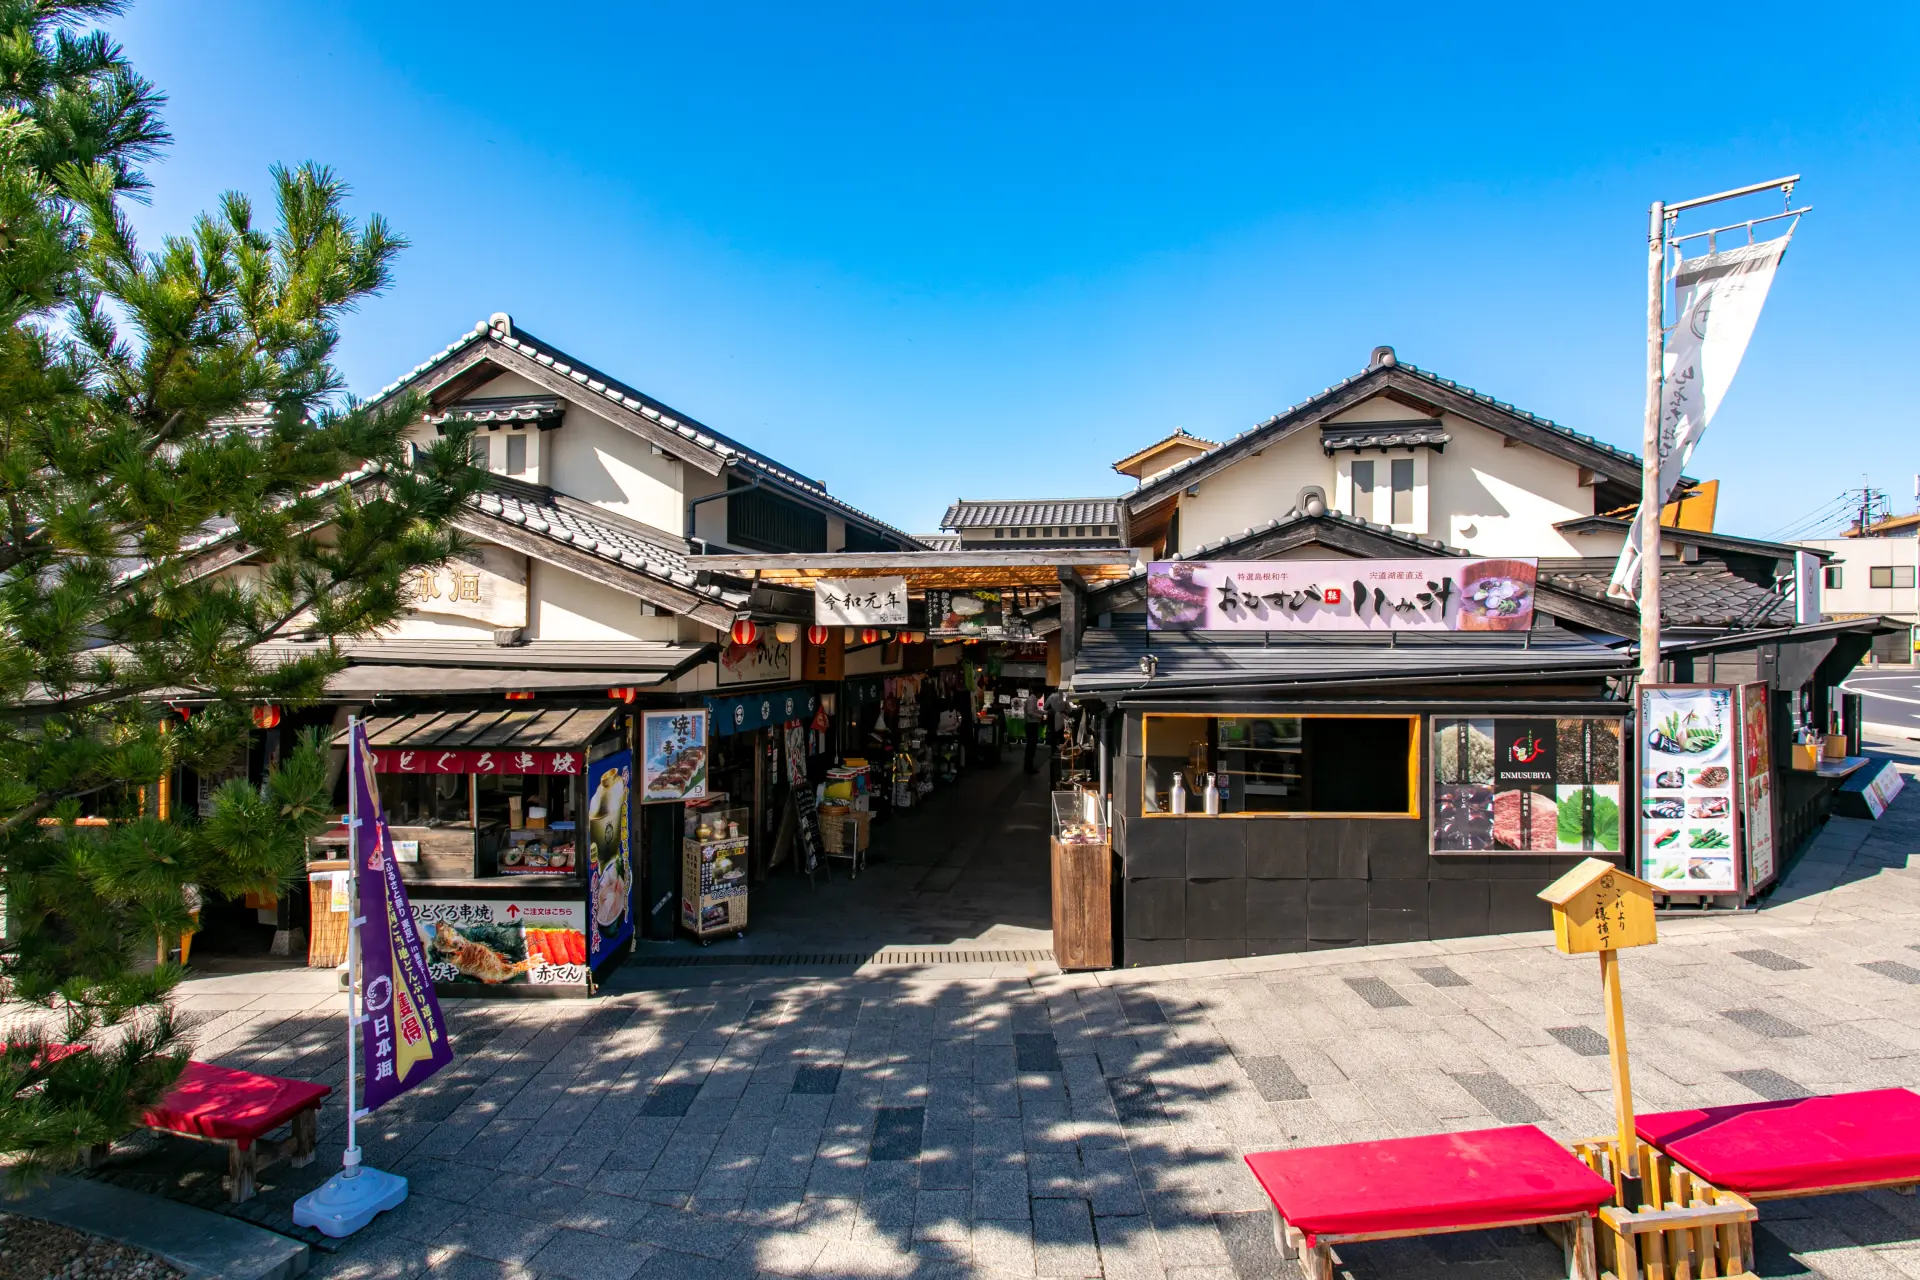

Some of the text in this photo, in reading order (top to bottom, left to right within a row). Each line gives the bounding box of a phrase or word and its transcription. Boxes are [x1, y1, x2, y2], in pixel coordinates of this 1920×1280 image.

[1237, 572, 1289, 581] 特選島根和牛
[1369, 571, 1424, 580] 宍道湖産直送
[822, 591, 901, 611] 令和元年
[1217, 576, 1323, 612] おむすび
[1353, 576, 1453, 618] しじみ汁
[1500, 771, 1552, 780] ENMUSUBIYA
[411, 904, 492, 921] のどぐろ串焼
[523, 907, 573, 916] ご注文はこちら
[1615, 889, 1625, 931] これより
[1595, 893, 1611, 948] ご縁横丁
[537, 965, 580, 982] 赤てん
[398, 991, 423, 1046] 獲得
[373, 1014, 393, 1081] 日本海
